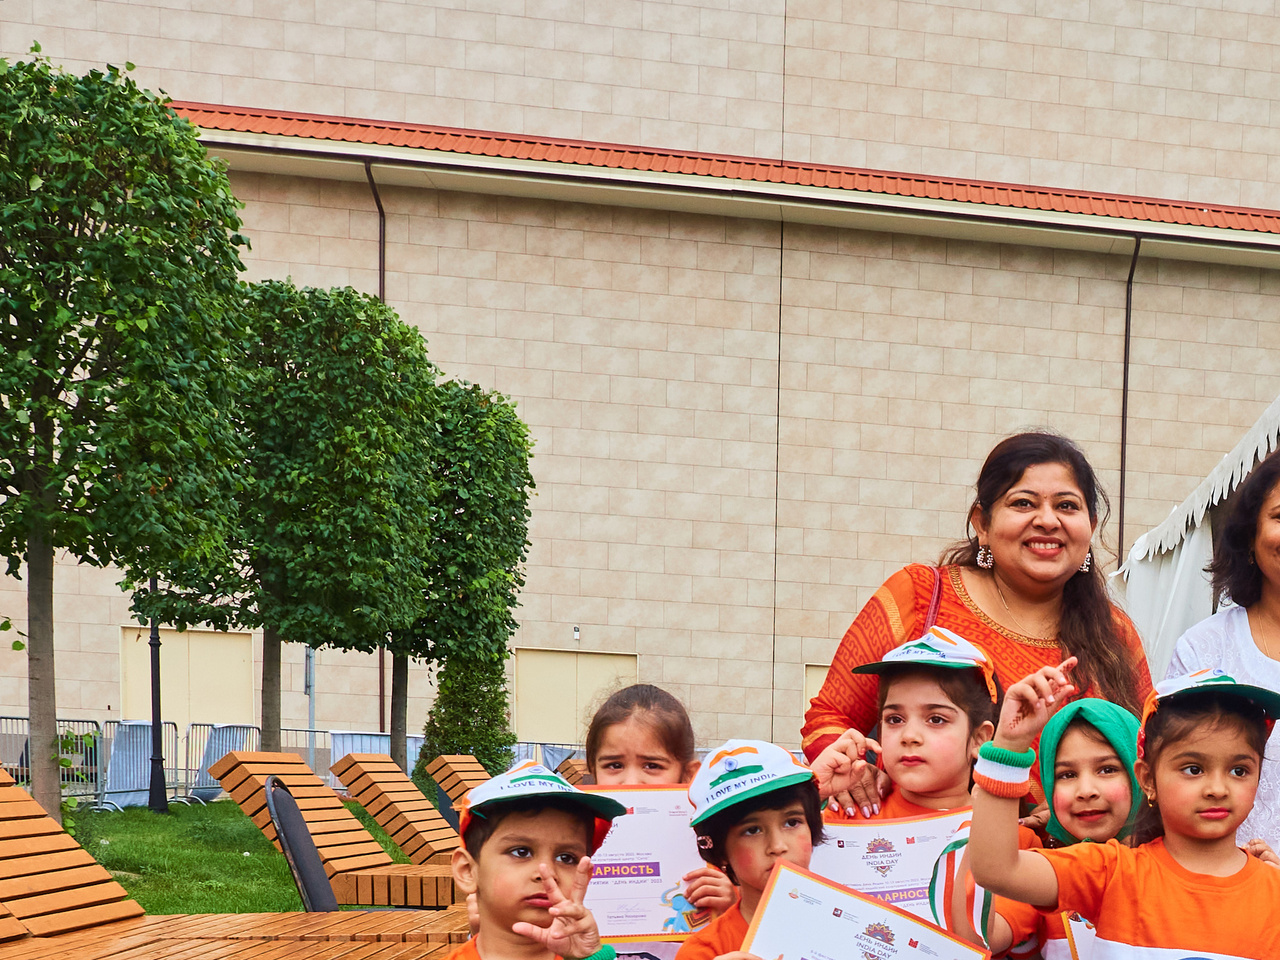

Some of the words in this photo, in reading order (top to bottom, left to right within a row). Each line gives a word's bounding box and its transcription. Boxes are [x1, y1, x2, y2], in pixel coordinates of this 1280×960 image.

[710, 785, 732, 801] LOVE
[734, 780, 747, 789] MY
[750, 773, 778, 784] INDIA
[592, 865, 654, 876] АРНОСТЬ
[854, 933, 873, 945] ДЕНЬ
[874, 940, 898, 954] ИНДИИ
[856, 941, 877, 956] INDIA
[877, 949, 892, 959] DAY
